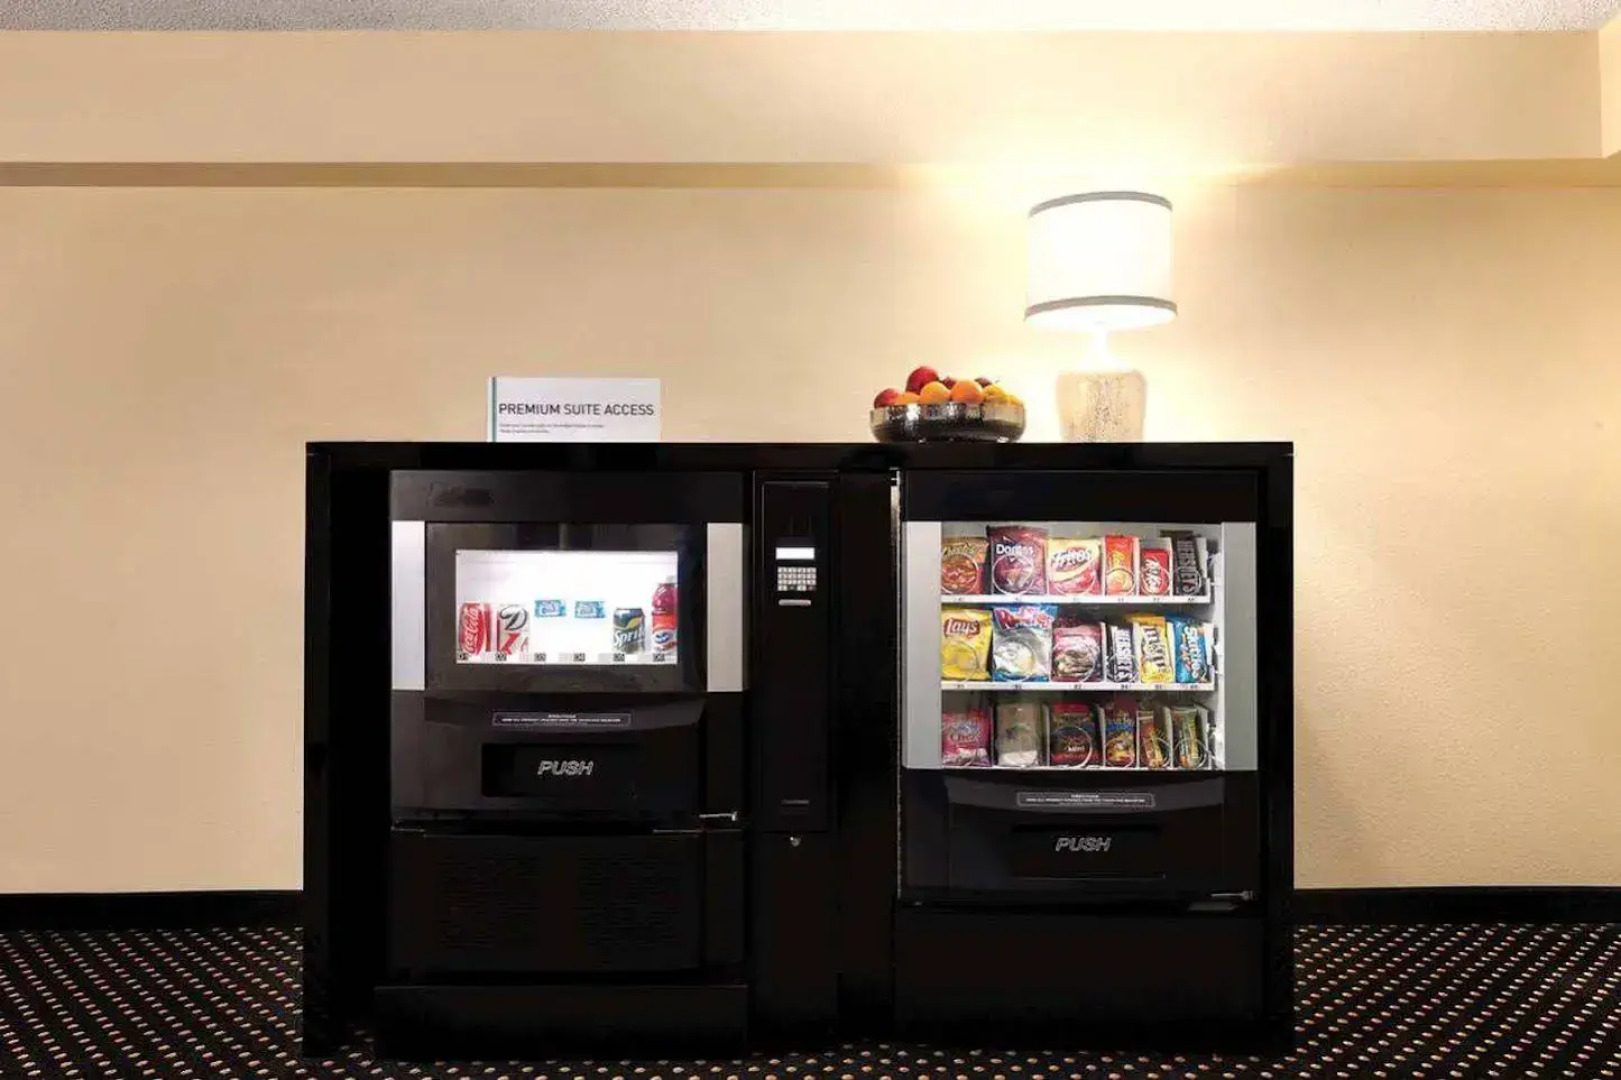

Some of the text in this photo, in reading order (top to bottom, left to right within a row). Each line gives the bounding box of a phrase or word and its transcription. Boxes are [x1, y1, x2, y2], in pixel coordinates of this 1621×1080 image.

[499, 403, 654, 415] PREMIUM SUITE ACCESS
[537, 760, 594, 776] PUSH
[1055, 837, 1111, 852] PUSH
